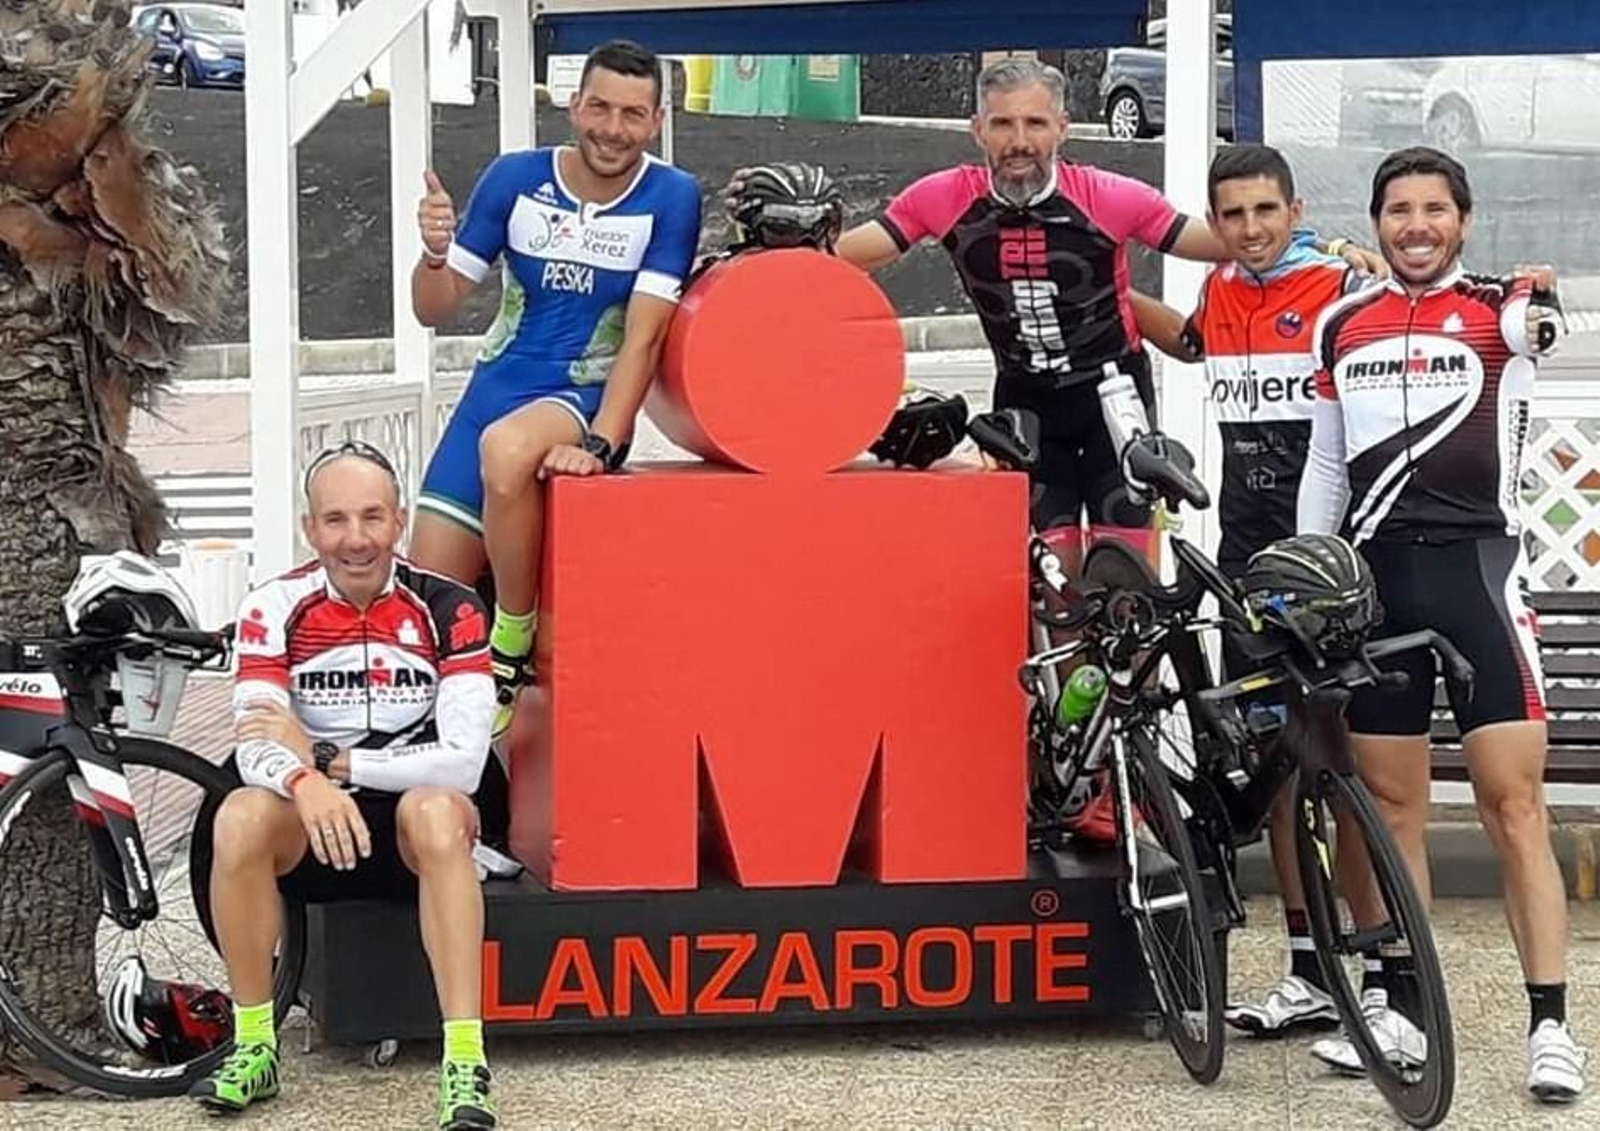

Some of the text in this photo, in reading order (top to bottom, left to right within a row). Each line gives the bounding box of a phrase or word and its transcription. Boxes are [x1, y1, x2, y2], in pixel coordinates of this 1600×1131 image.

[541, 261, 595, 295] PESKA
[1345, 348, 1467, 379] IRONMAN
[299, 657, 433, 690] IRONMAN
[480, 922, 1090, 1020] LANZAROTE
